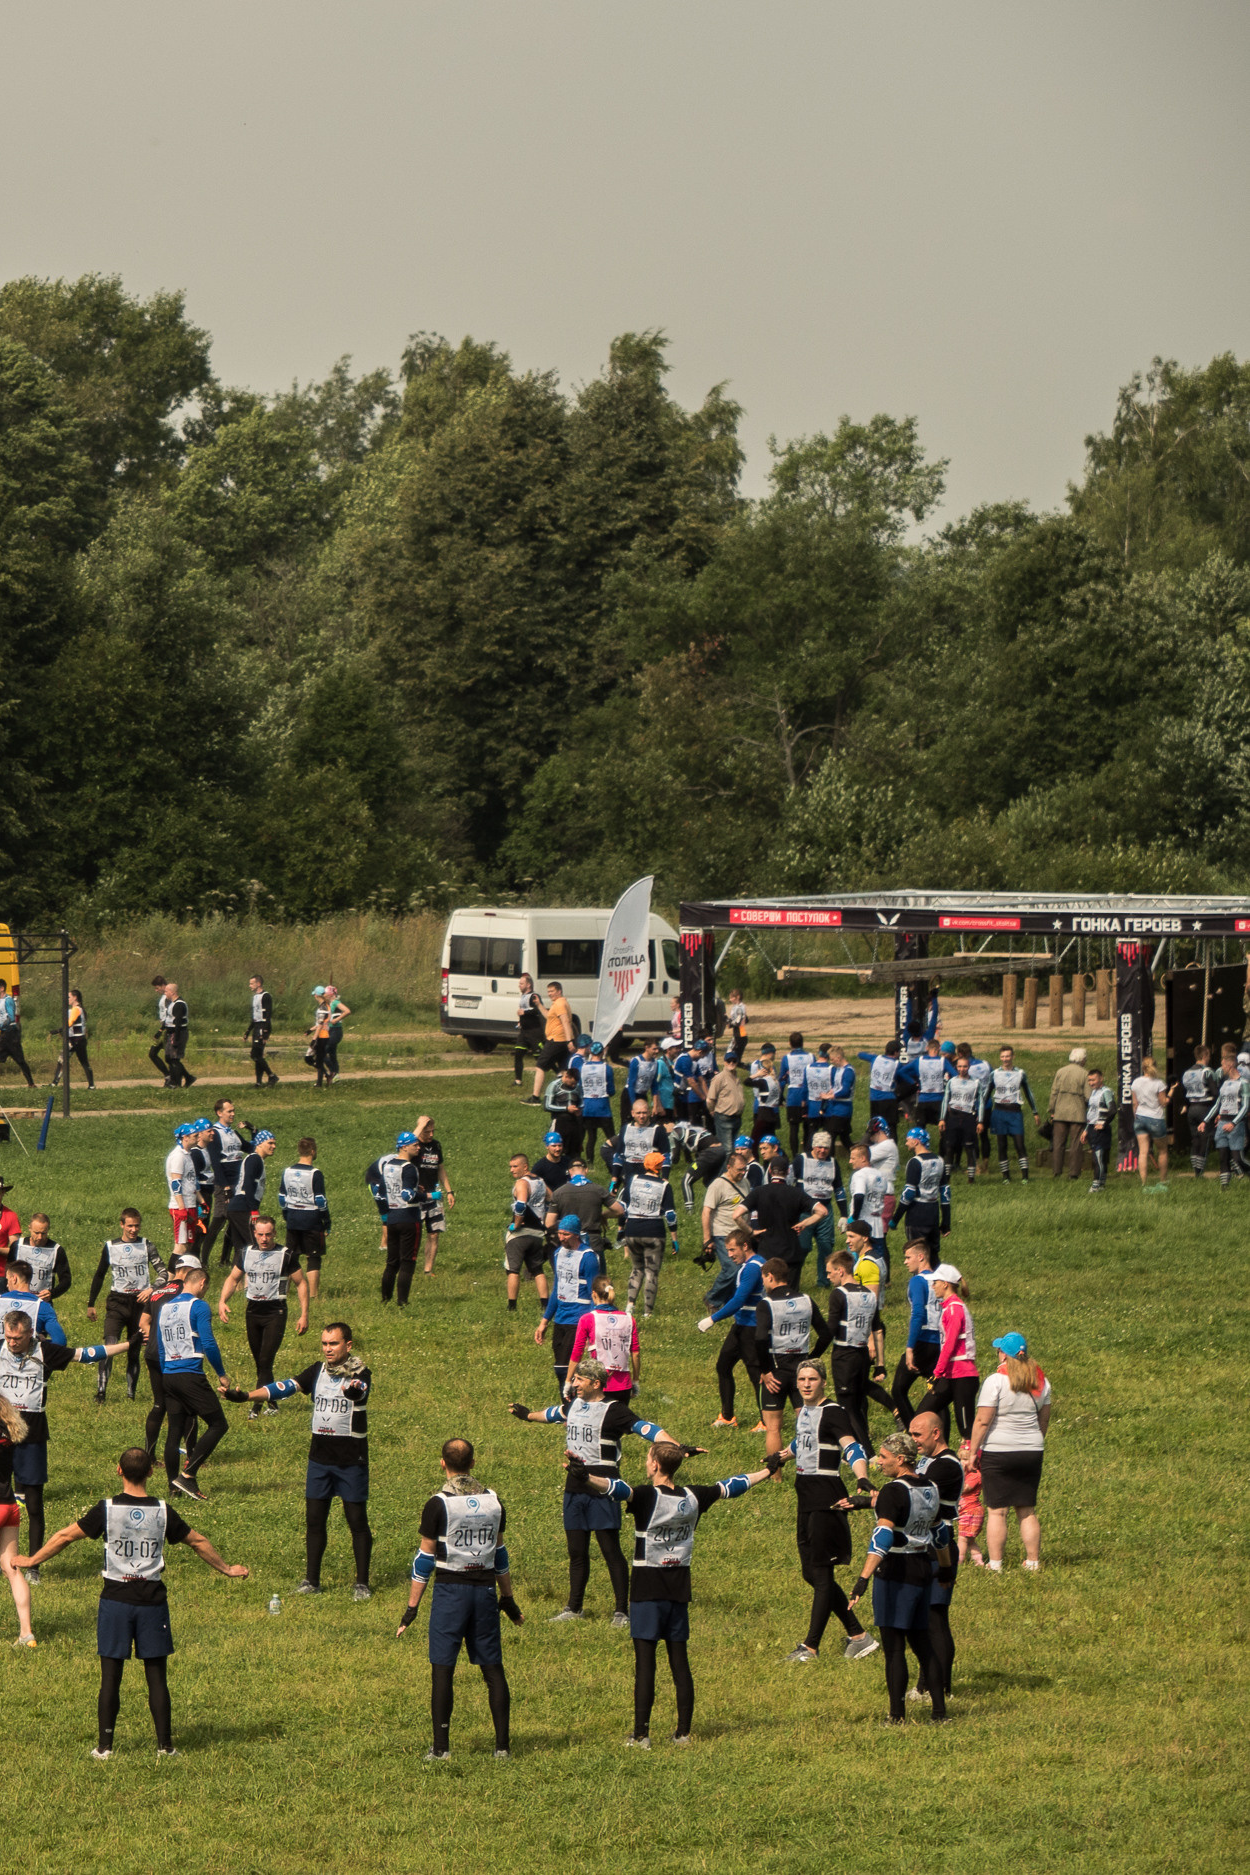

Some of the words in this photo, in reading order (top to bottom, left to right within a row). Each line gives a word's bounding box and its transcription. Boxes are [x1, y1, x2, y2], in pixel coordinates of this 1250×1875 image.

[741, 911, 781, 922] СОВЕРШИ
[786, 912, 829, 923] ПОСТУПОК
[1072, 917, 1121, 931] ГОНКА
[1124, 918, 1182, 932] ГЕРОЕВ
[684, 1002, 693, 1048] ГЕРОЕВ
[1121, 1013, 1132, 1060] ГЕРОЕВ
[1122, 1063, 1132, 1104] ГОНКА
[164, 1327, 186, 1342] 01-19
[2, 1375, 37, 1390] 20-17
[315, 1397, 349, 1414] 20-08
[454, 1527, 495, 1547] 20-04
[114, 1540, 159, 1559] 20-02
